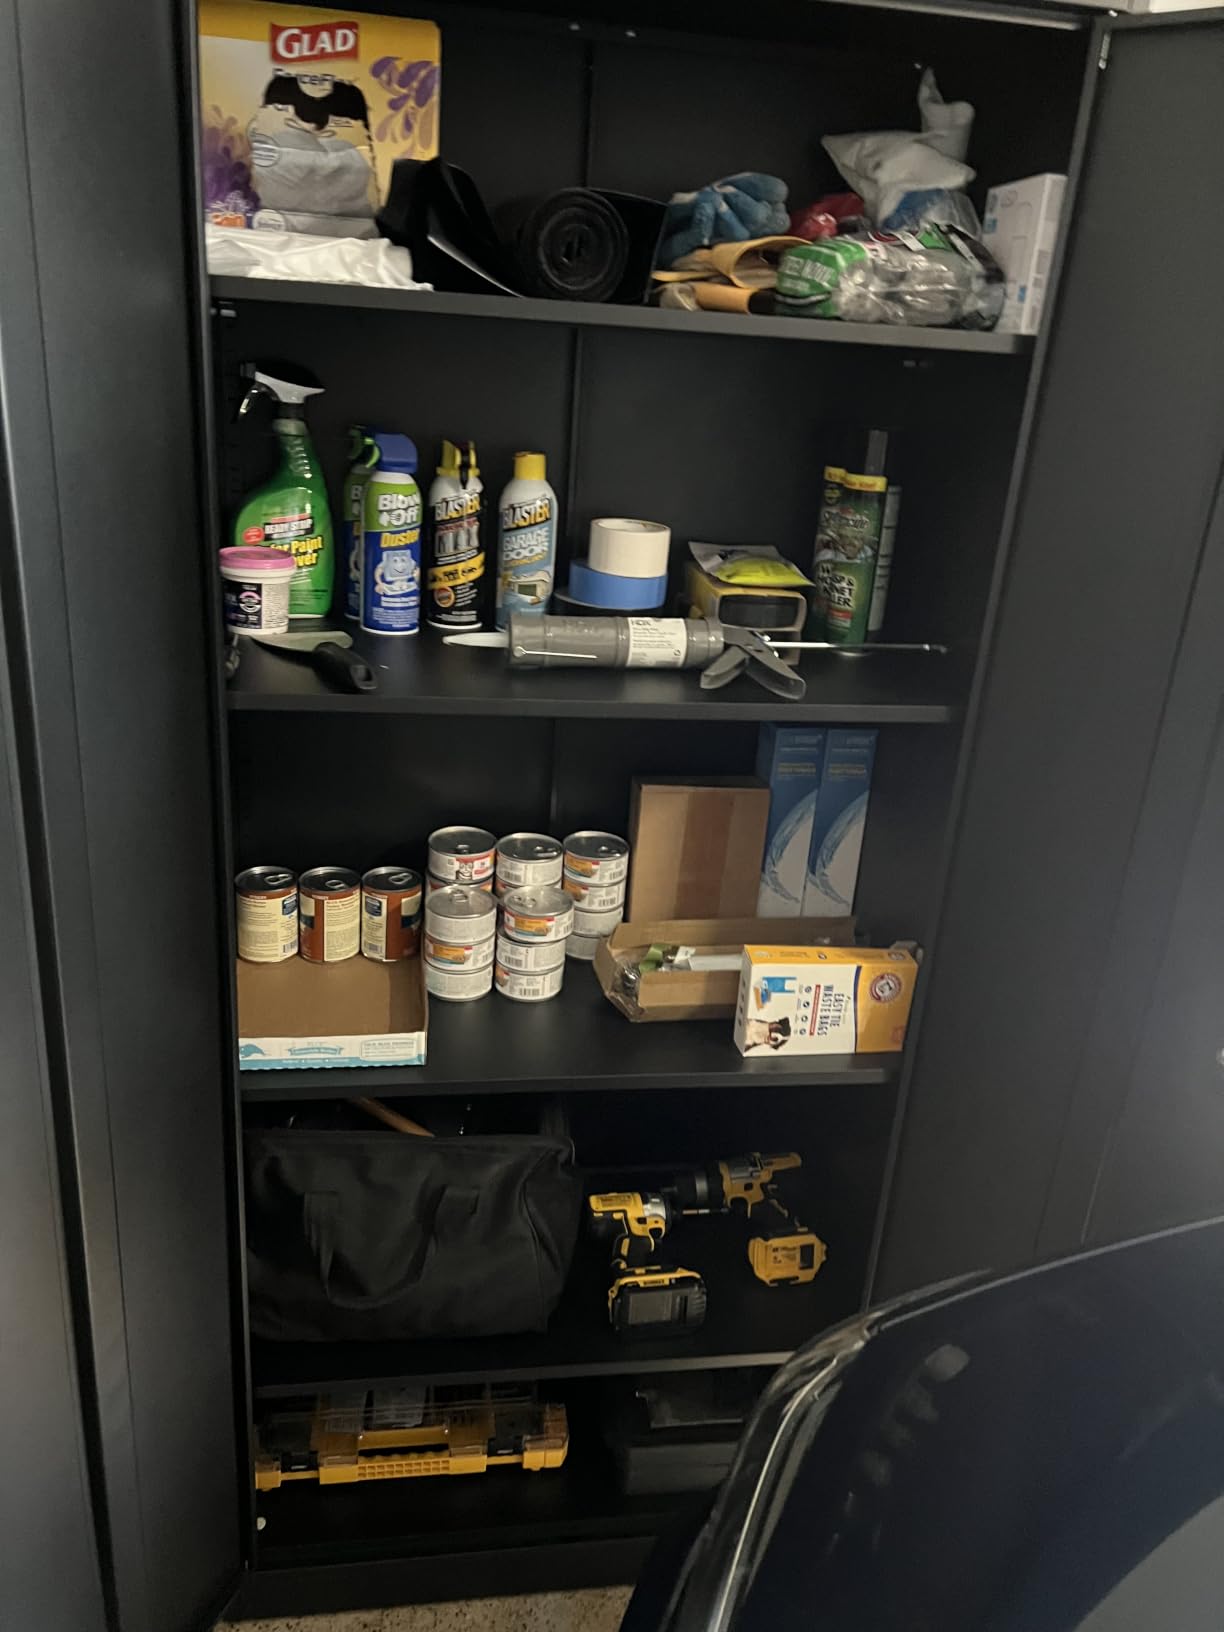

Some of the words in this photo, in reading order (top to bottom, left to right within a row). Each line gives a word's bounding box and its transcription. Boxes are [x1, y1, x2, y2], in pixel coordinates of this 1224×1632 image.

[275, 28, 356, 58] GLAD
[291, 536, 322, 554] Paint
[821, 985, 834, 1013] WASTE
[833, 993, 845, 1012] EASY
[817, 1015, 830, 1036] BAGS
[829, 1014, 841, 1028] TIE
